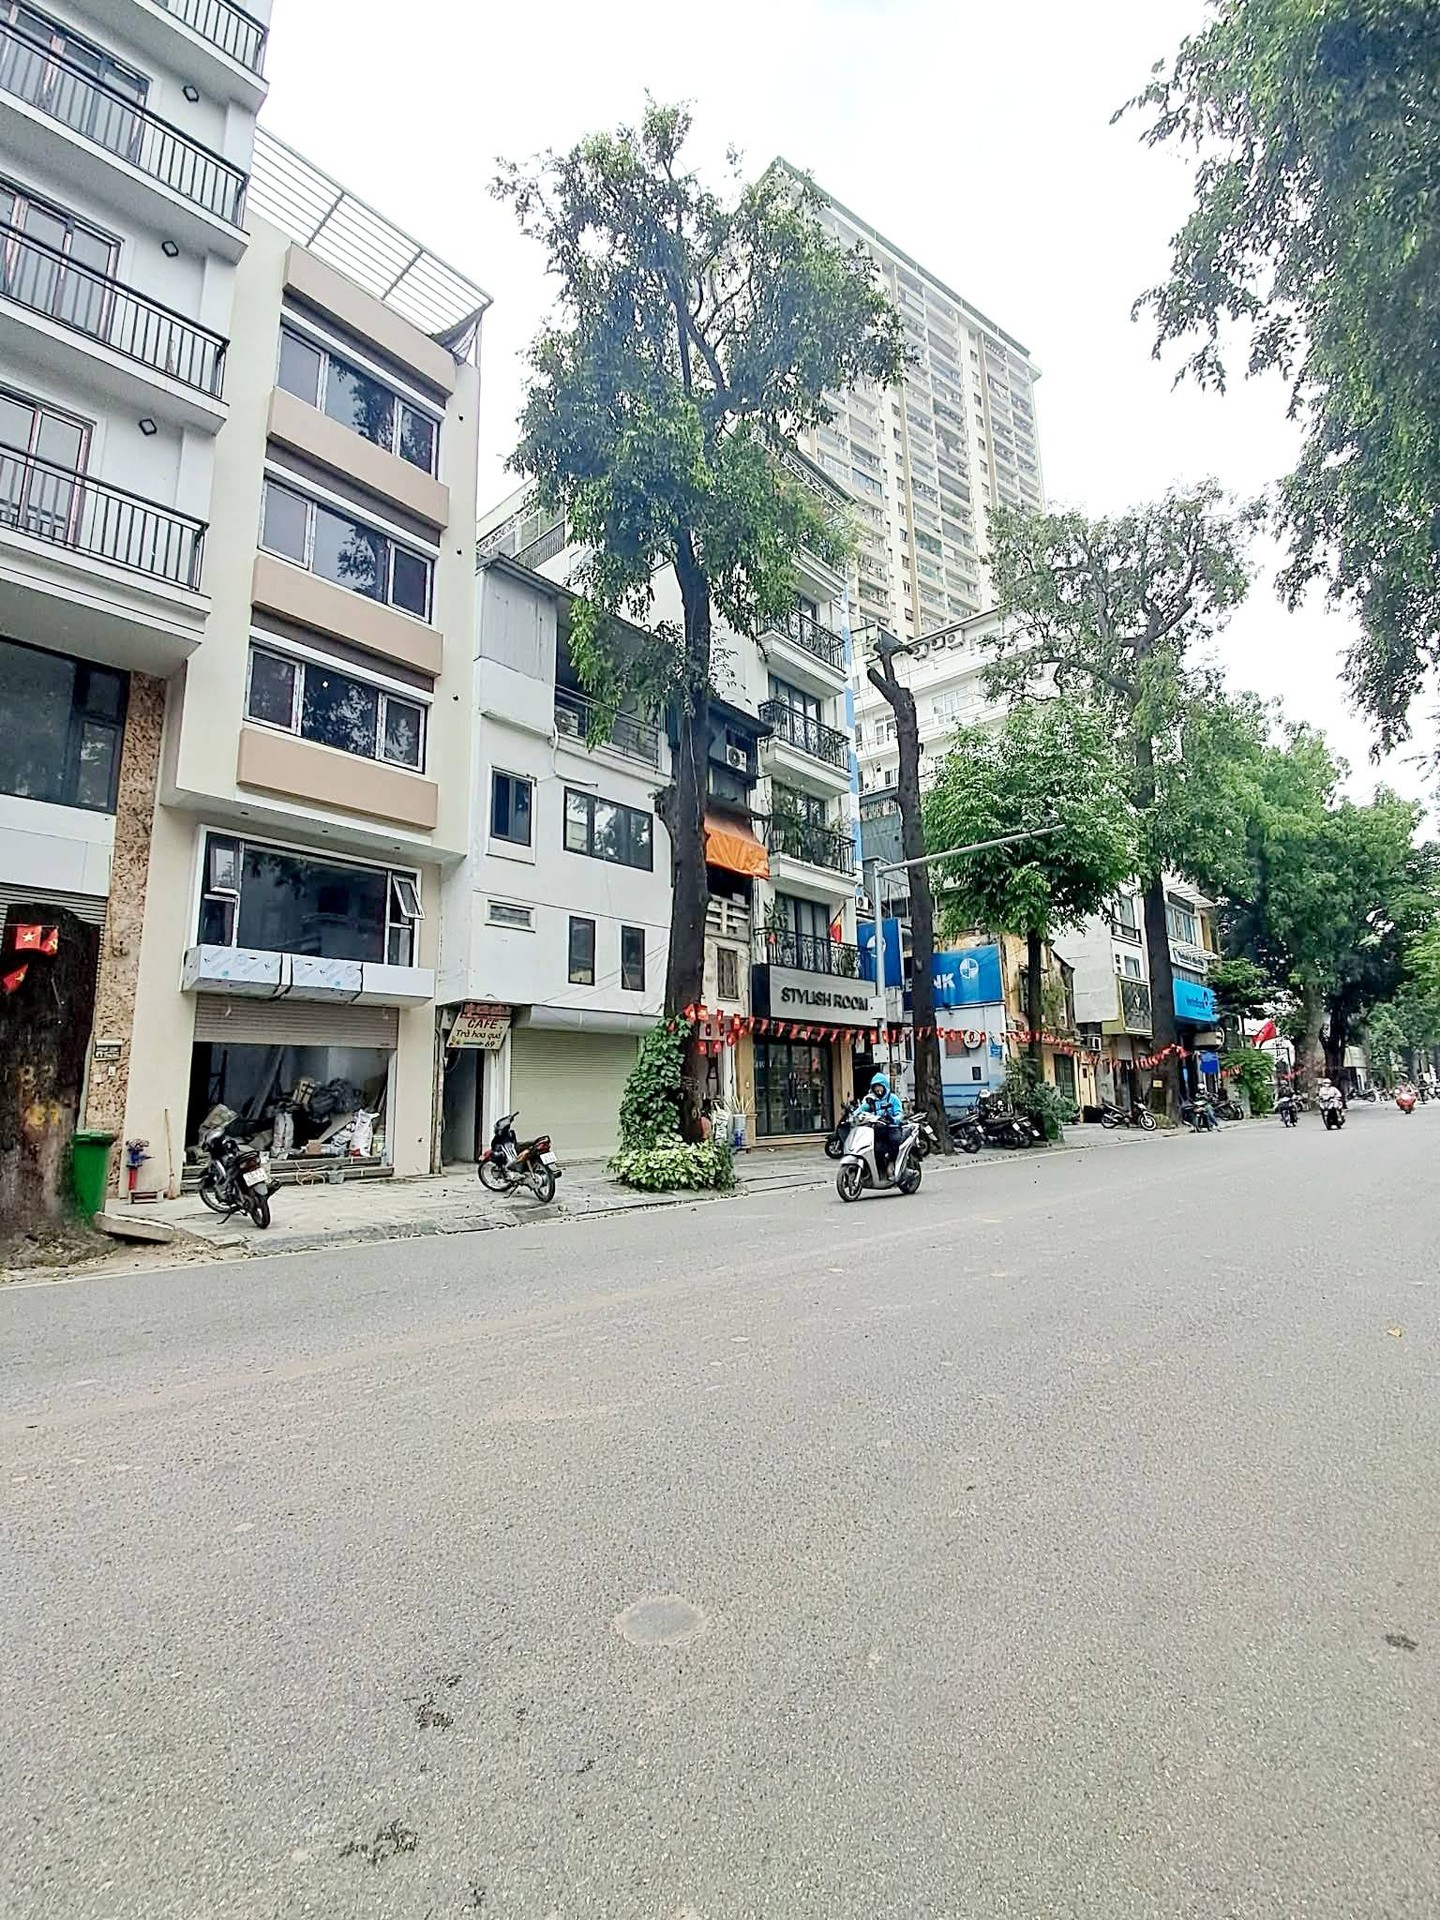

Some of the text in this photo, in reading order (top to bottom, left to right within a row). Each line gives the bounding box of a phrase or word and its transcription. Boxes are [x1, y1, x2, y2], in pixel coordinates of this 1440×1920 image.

[781, 986, 868, 1011] STYLISH ROOM
[471, 1030, 486, 1038] hoa
[484, 1040, 496, 1048] 69
